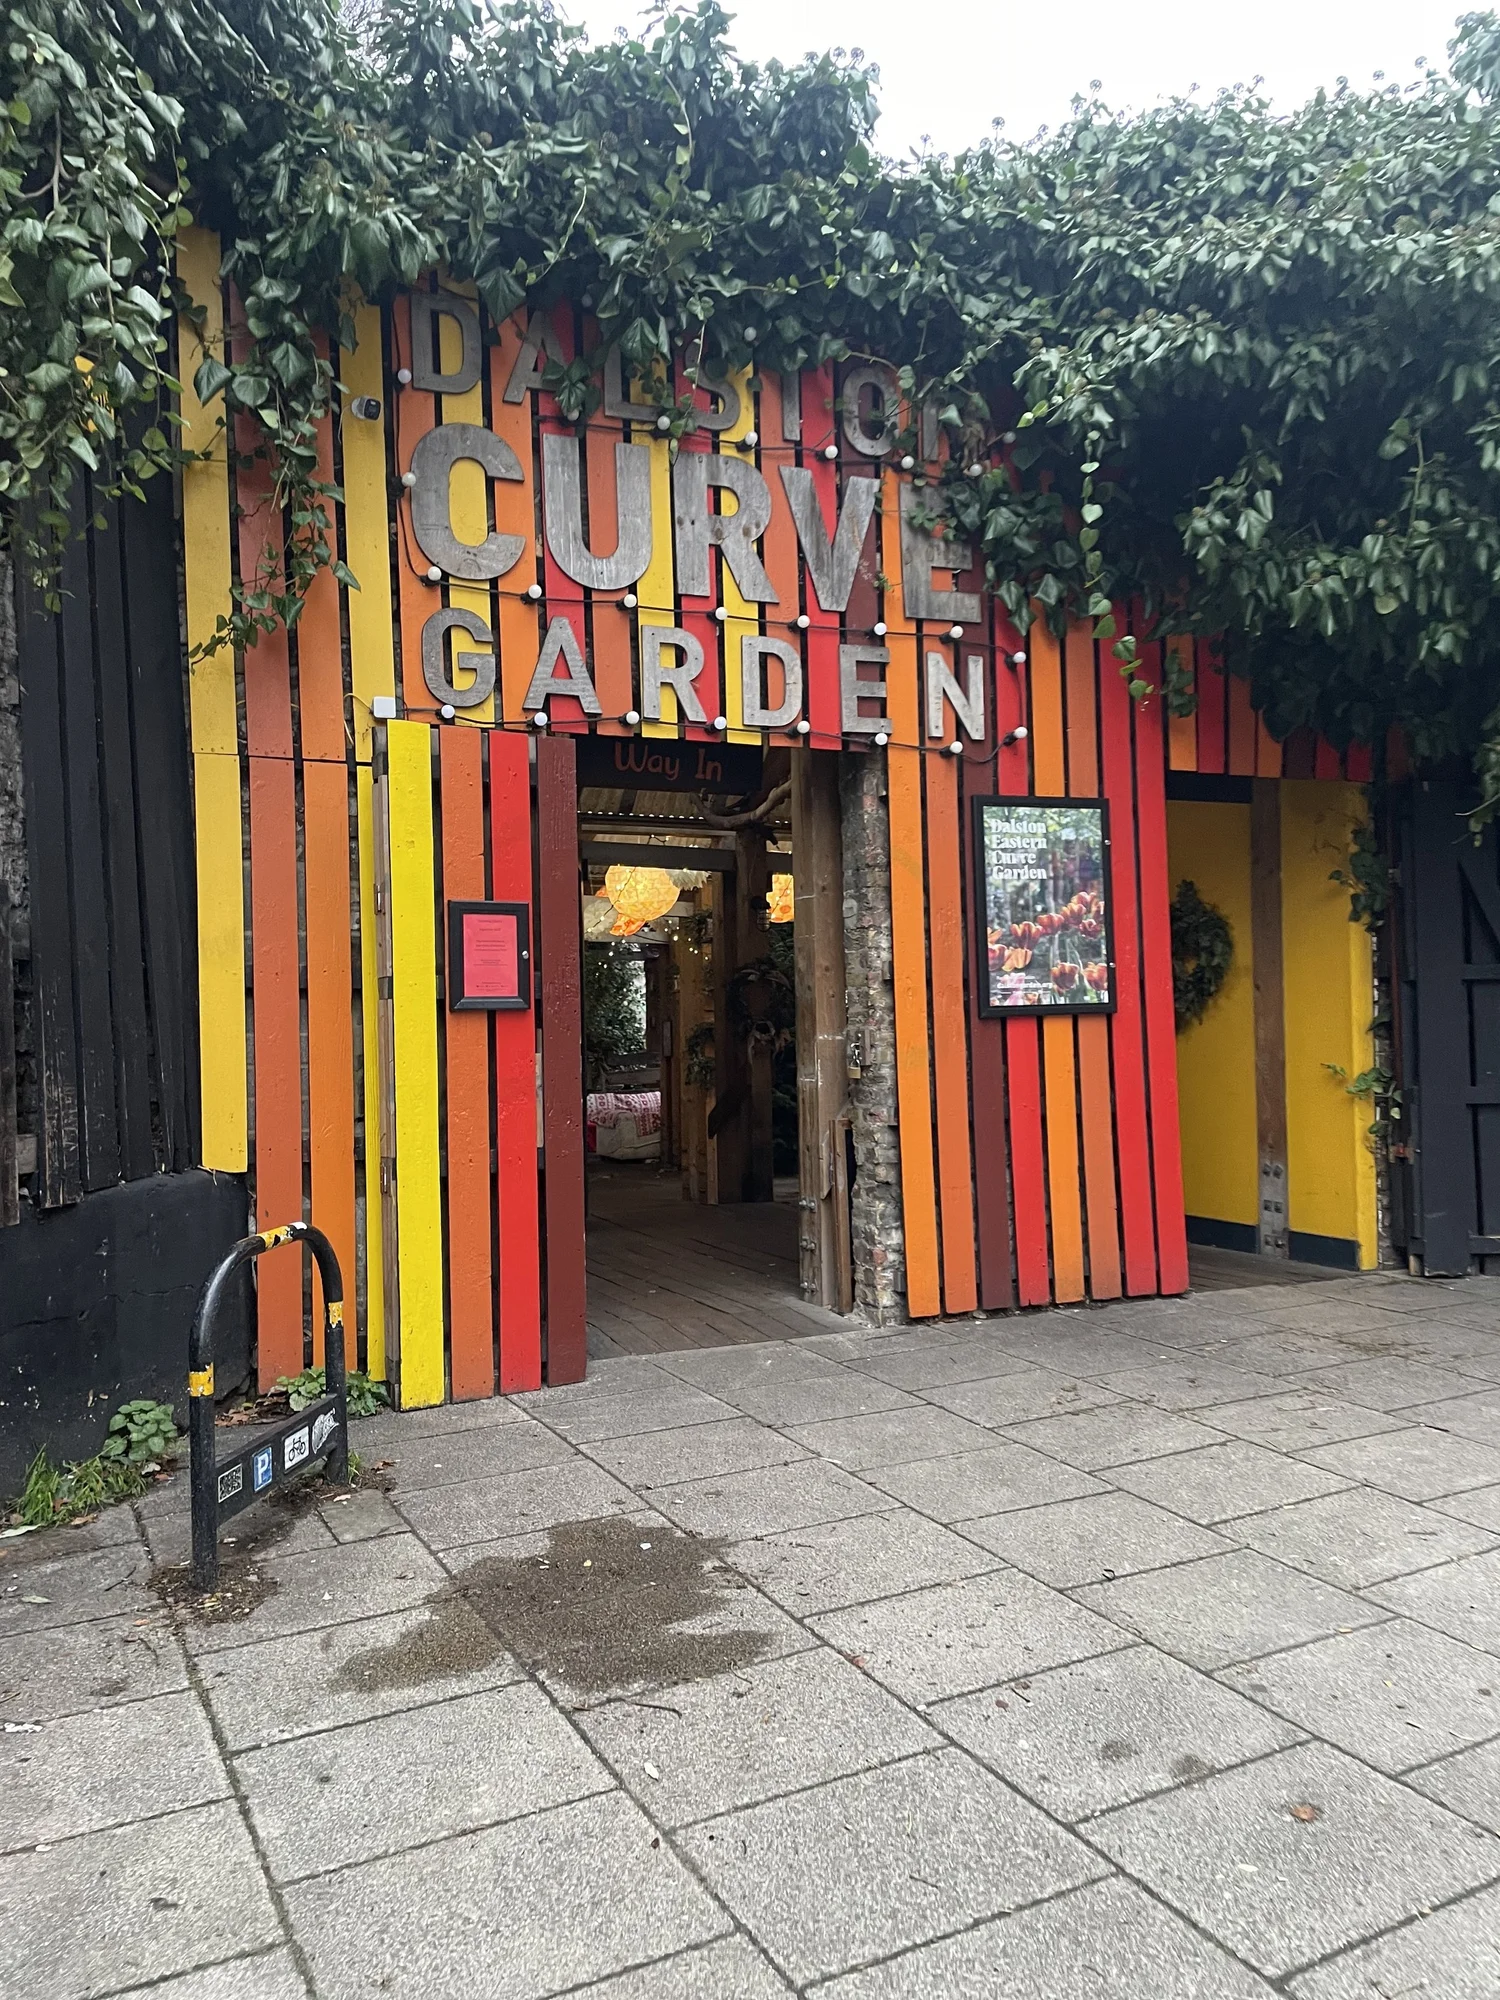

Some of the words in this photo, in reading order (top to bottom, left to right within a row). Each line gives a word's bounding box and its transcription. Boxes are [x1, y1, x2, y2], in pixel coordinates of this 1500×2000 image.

[411, 290, 944, 462] DALSO
[411, 422, 982, 623] CURVE
[422, 607, 985, 741] GARDEN
[614, 741, 680, 781] Way
[694, 748, 722, 782] In
[990, 818, 1047, 834] Dalston
[991, 834, 1048, 849] Eastern
[991, 850, 1037, 865] Curve
[992, 864, 1048, 880] Garden
[257, 1452, 269, 1485] P
